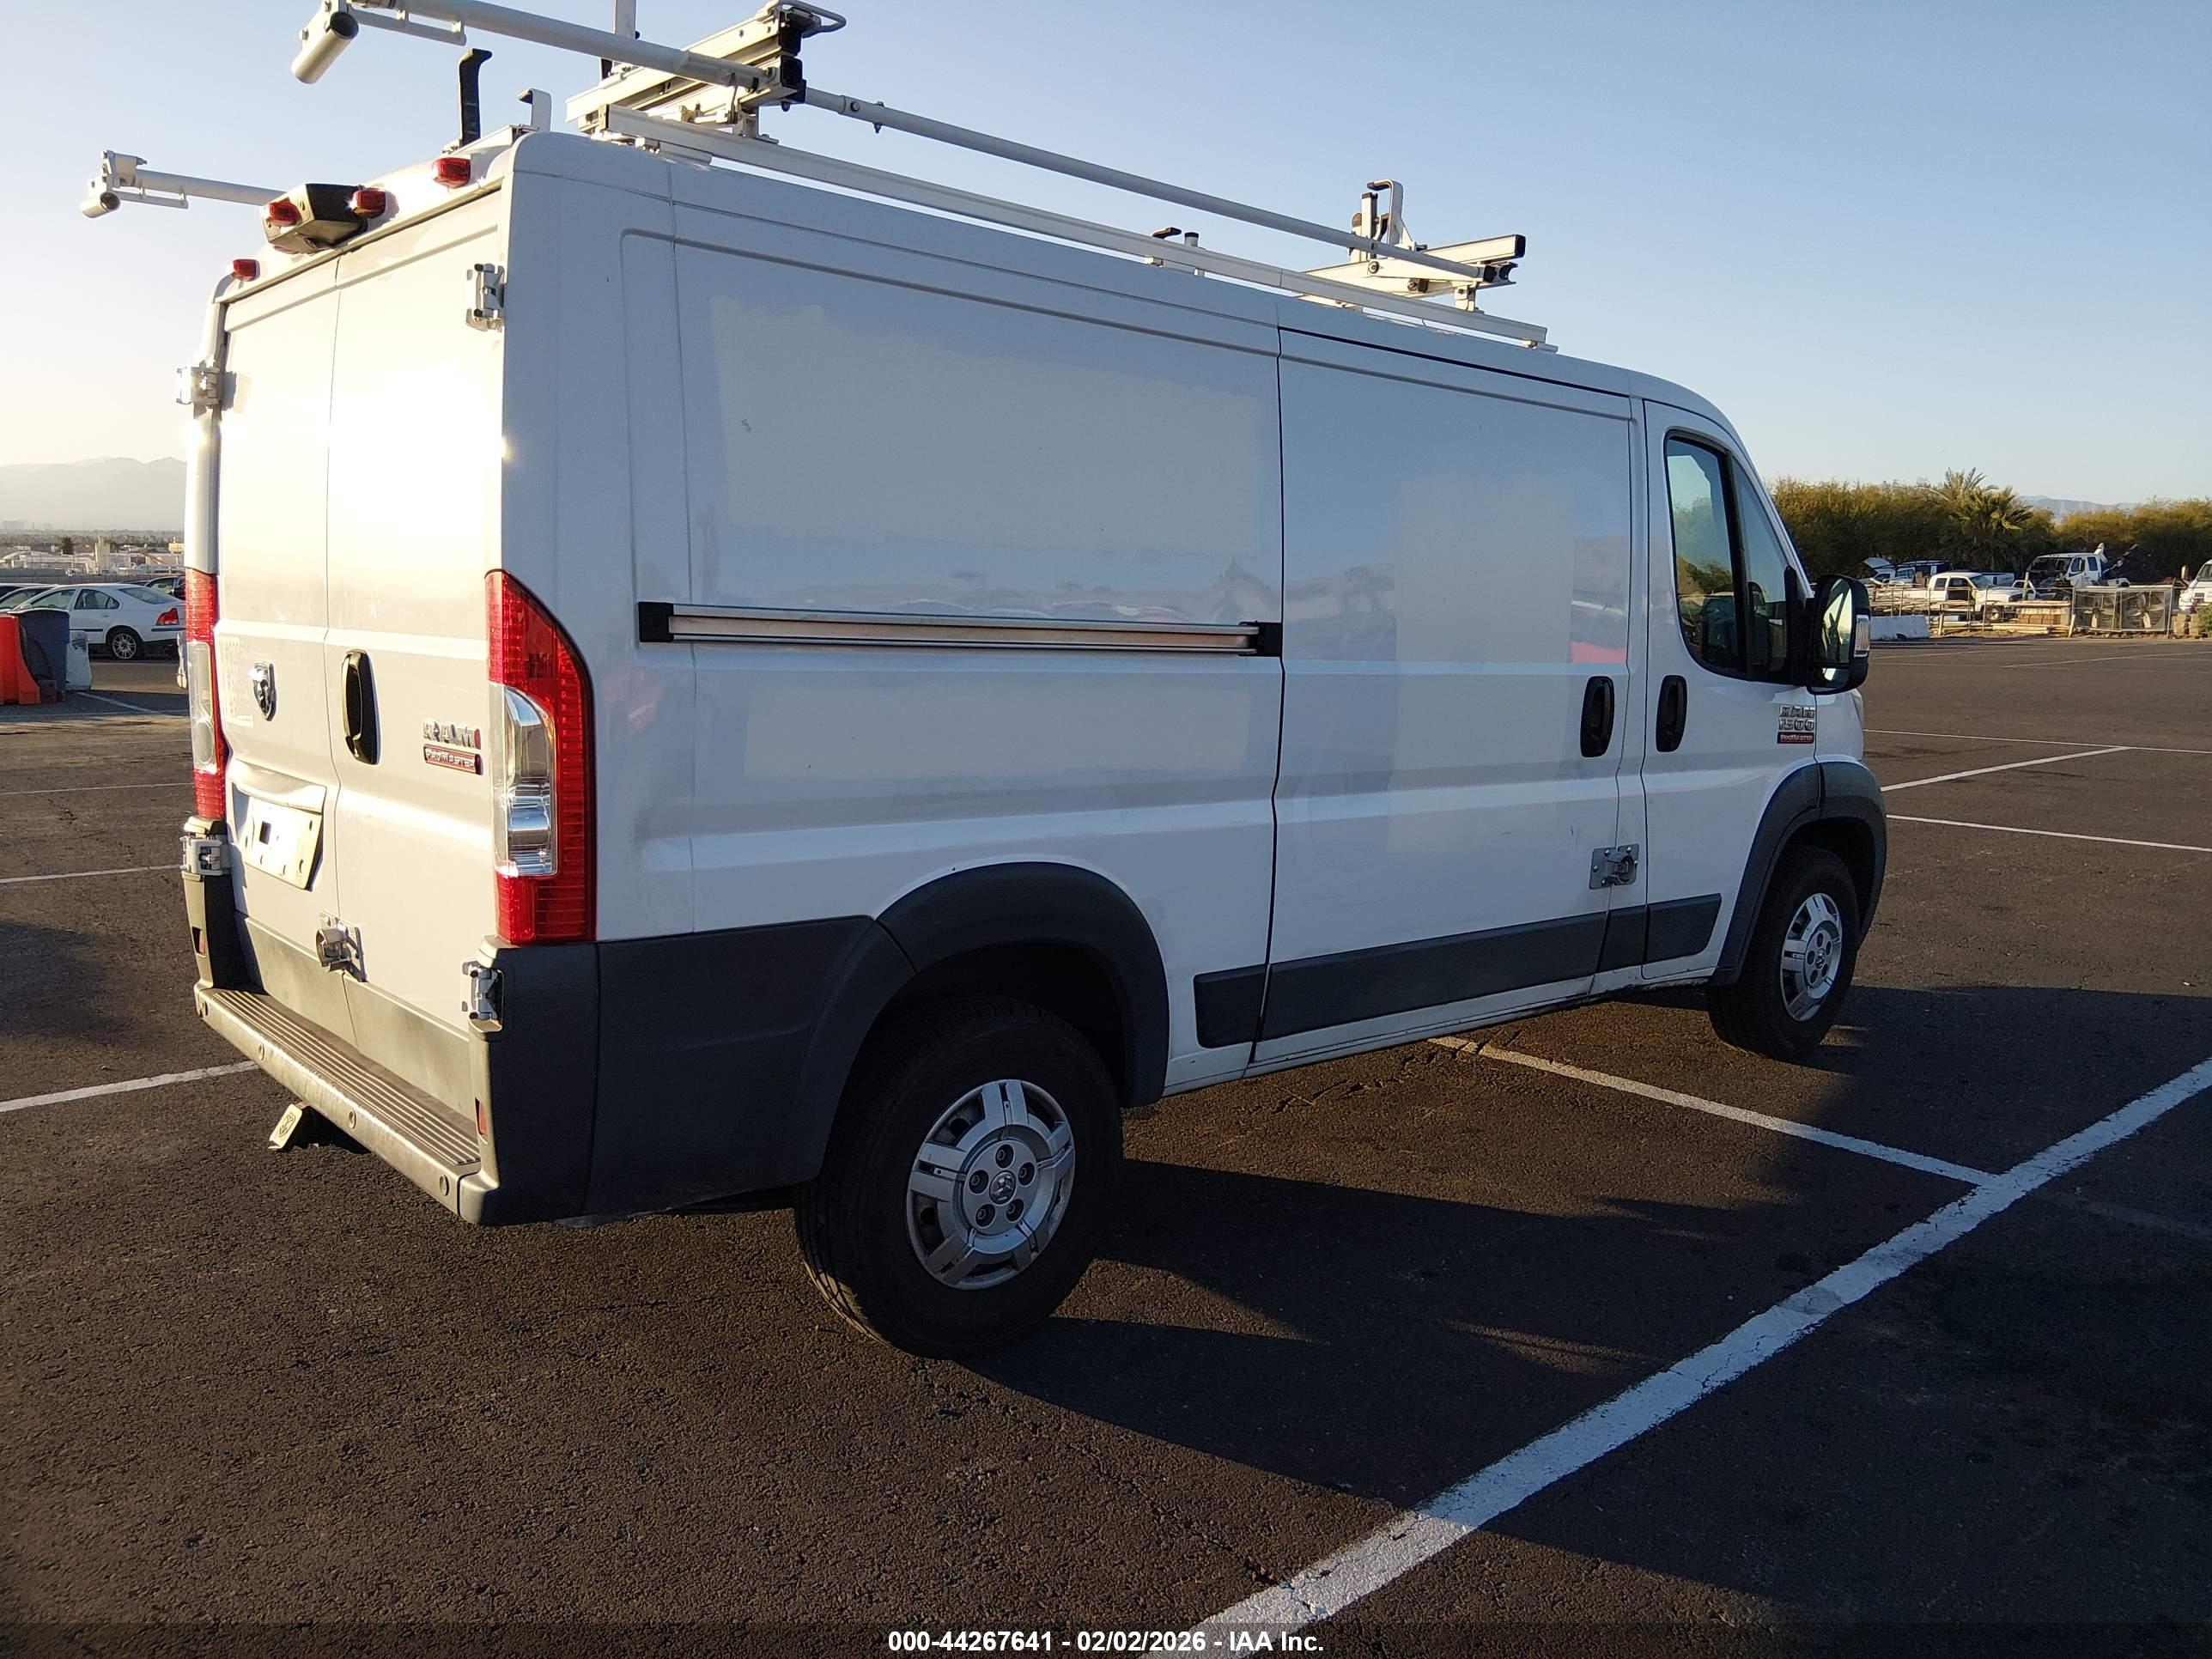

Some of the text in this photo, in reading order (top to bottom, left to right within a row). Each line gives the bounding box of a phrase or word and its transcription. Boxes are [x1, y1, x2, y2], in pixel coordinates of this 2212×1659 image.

[1779, 705, 1814, 718] RAM
[1778, 718, 1814, 731] 1500
[422, 720, 481, 749] RAM
